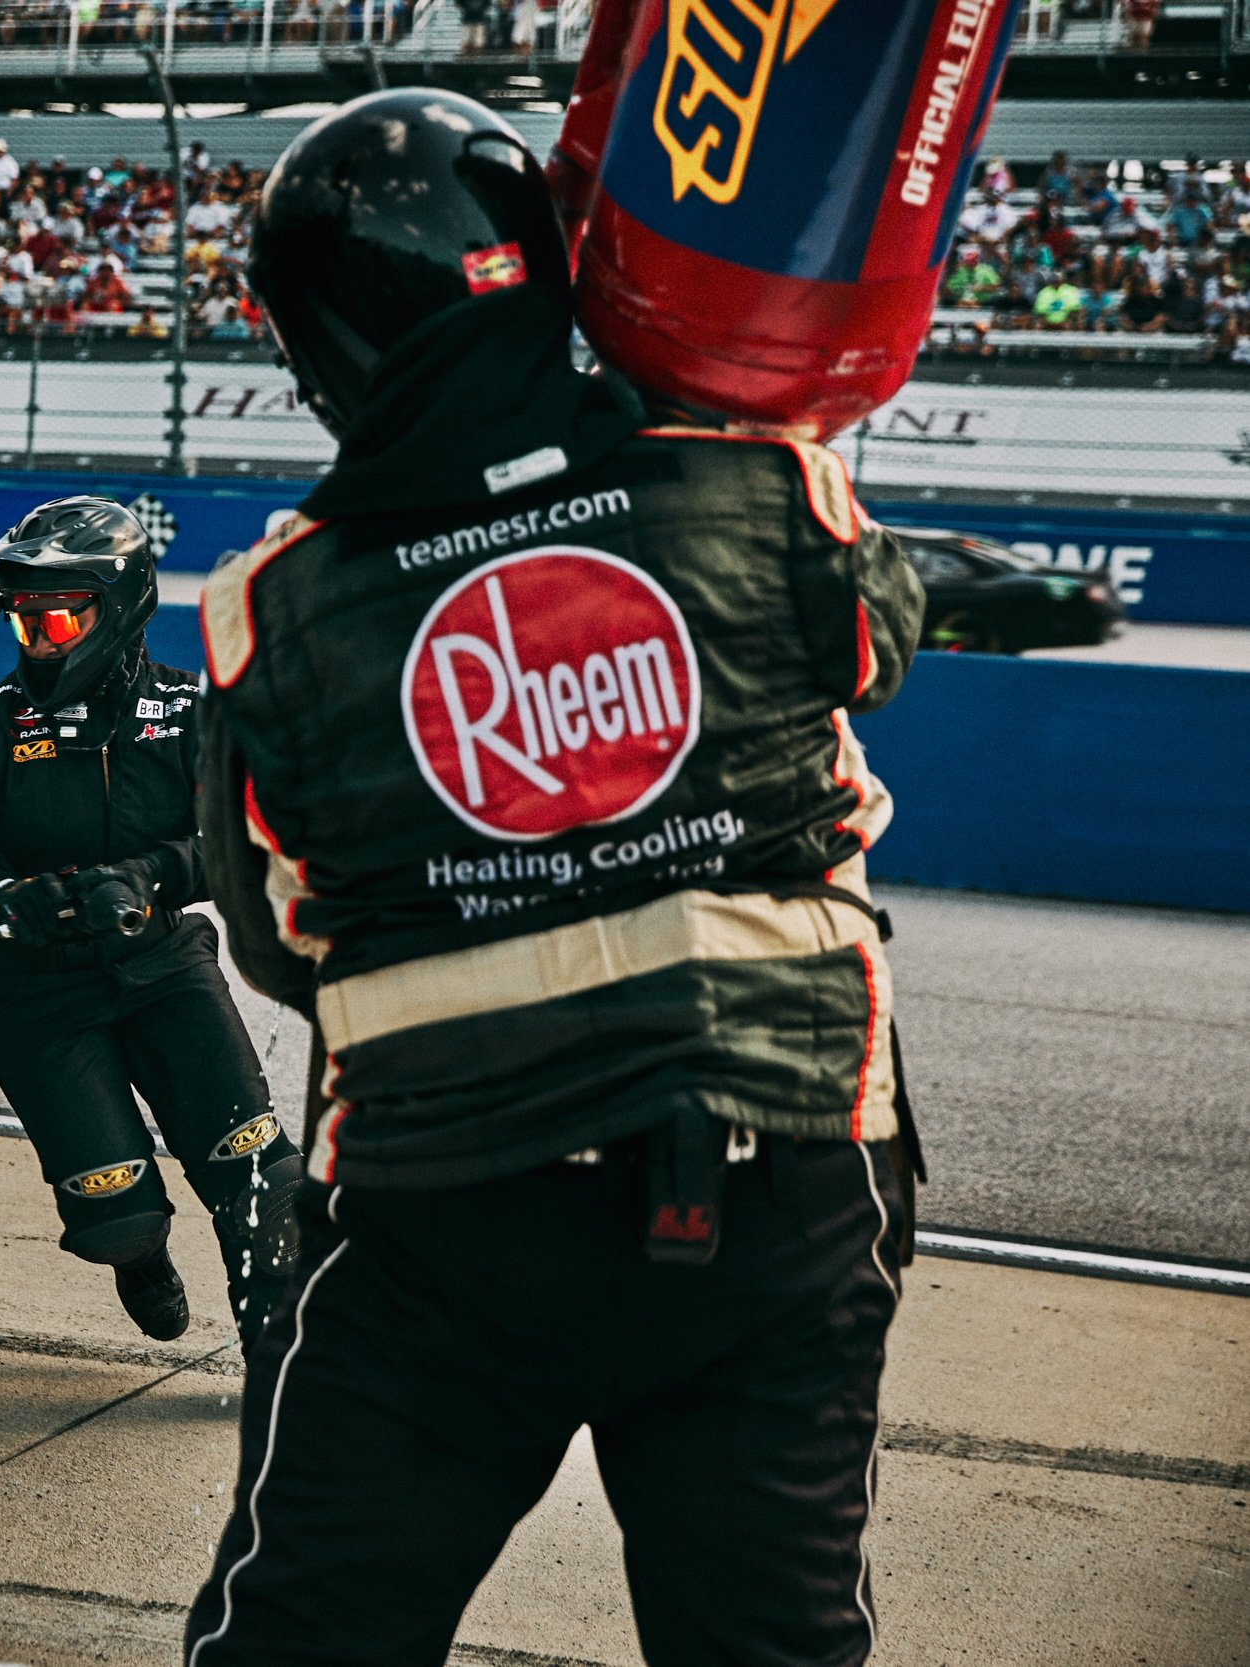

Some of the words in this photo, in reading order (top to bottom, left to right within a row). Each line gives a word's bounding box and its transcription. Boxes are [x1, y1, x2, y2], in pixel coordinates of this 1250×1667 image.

[901, 57, 966, 207] OFFICIAL
[396, 489, 630, 570] teamesr.com
[431, 576, 683, 807] Rheem
[427, 848, 582, 886] Heating,
[590, 810, 745, 869] Cooling,
